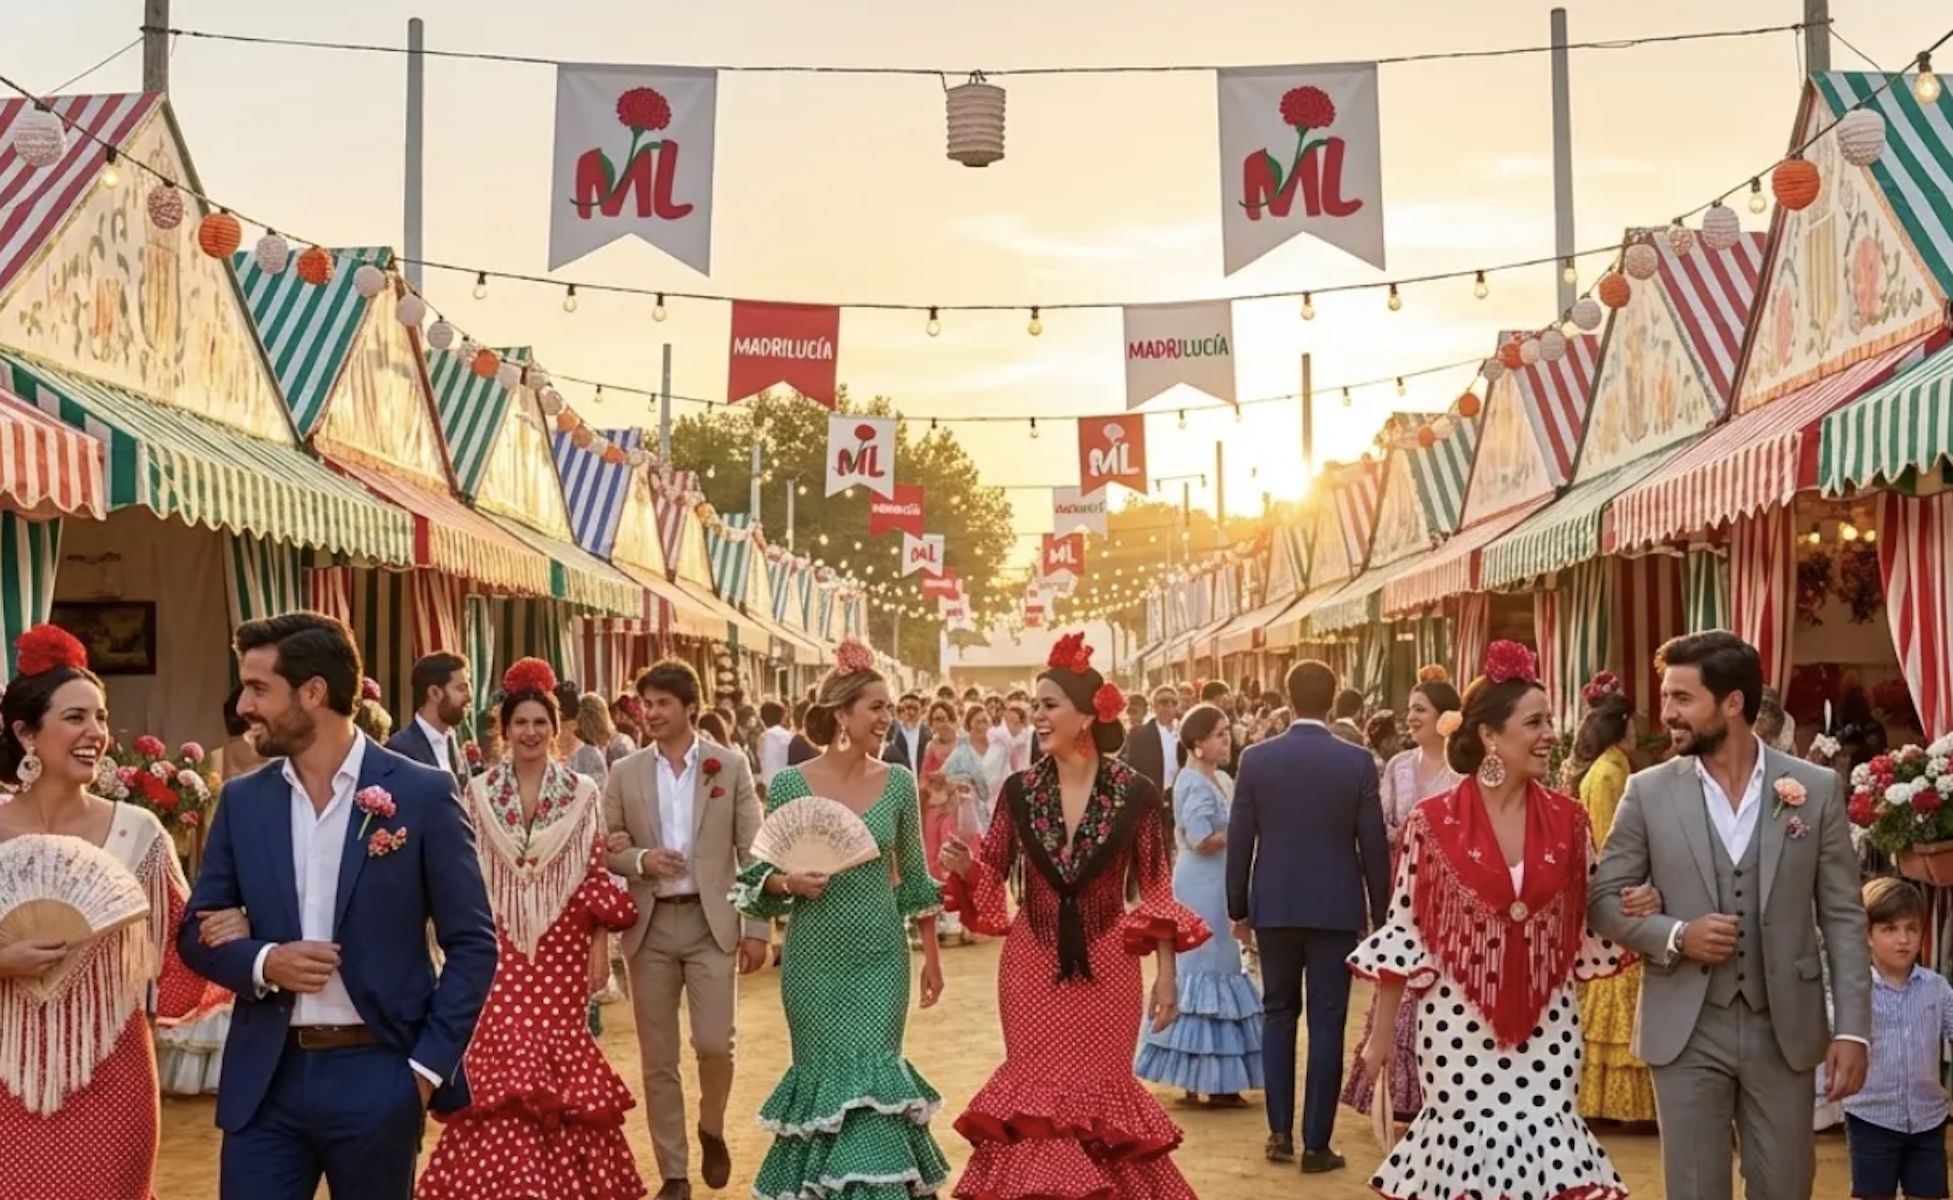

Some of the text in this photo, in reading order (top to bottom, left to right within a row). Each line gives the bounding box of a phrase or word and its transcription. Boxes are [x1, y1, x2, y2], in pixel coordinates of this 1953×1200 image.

[576, 139, 694, 220] ML
[1243, 136, 1364, 221] ML
[734, 336, 833, 360] MADRILUCÍA
[1129, 333, 1229, 359] MADRILUCÍA
[837, 445, 885, 478] ML
[1089, 442, 1140, 477] ML
